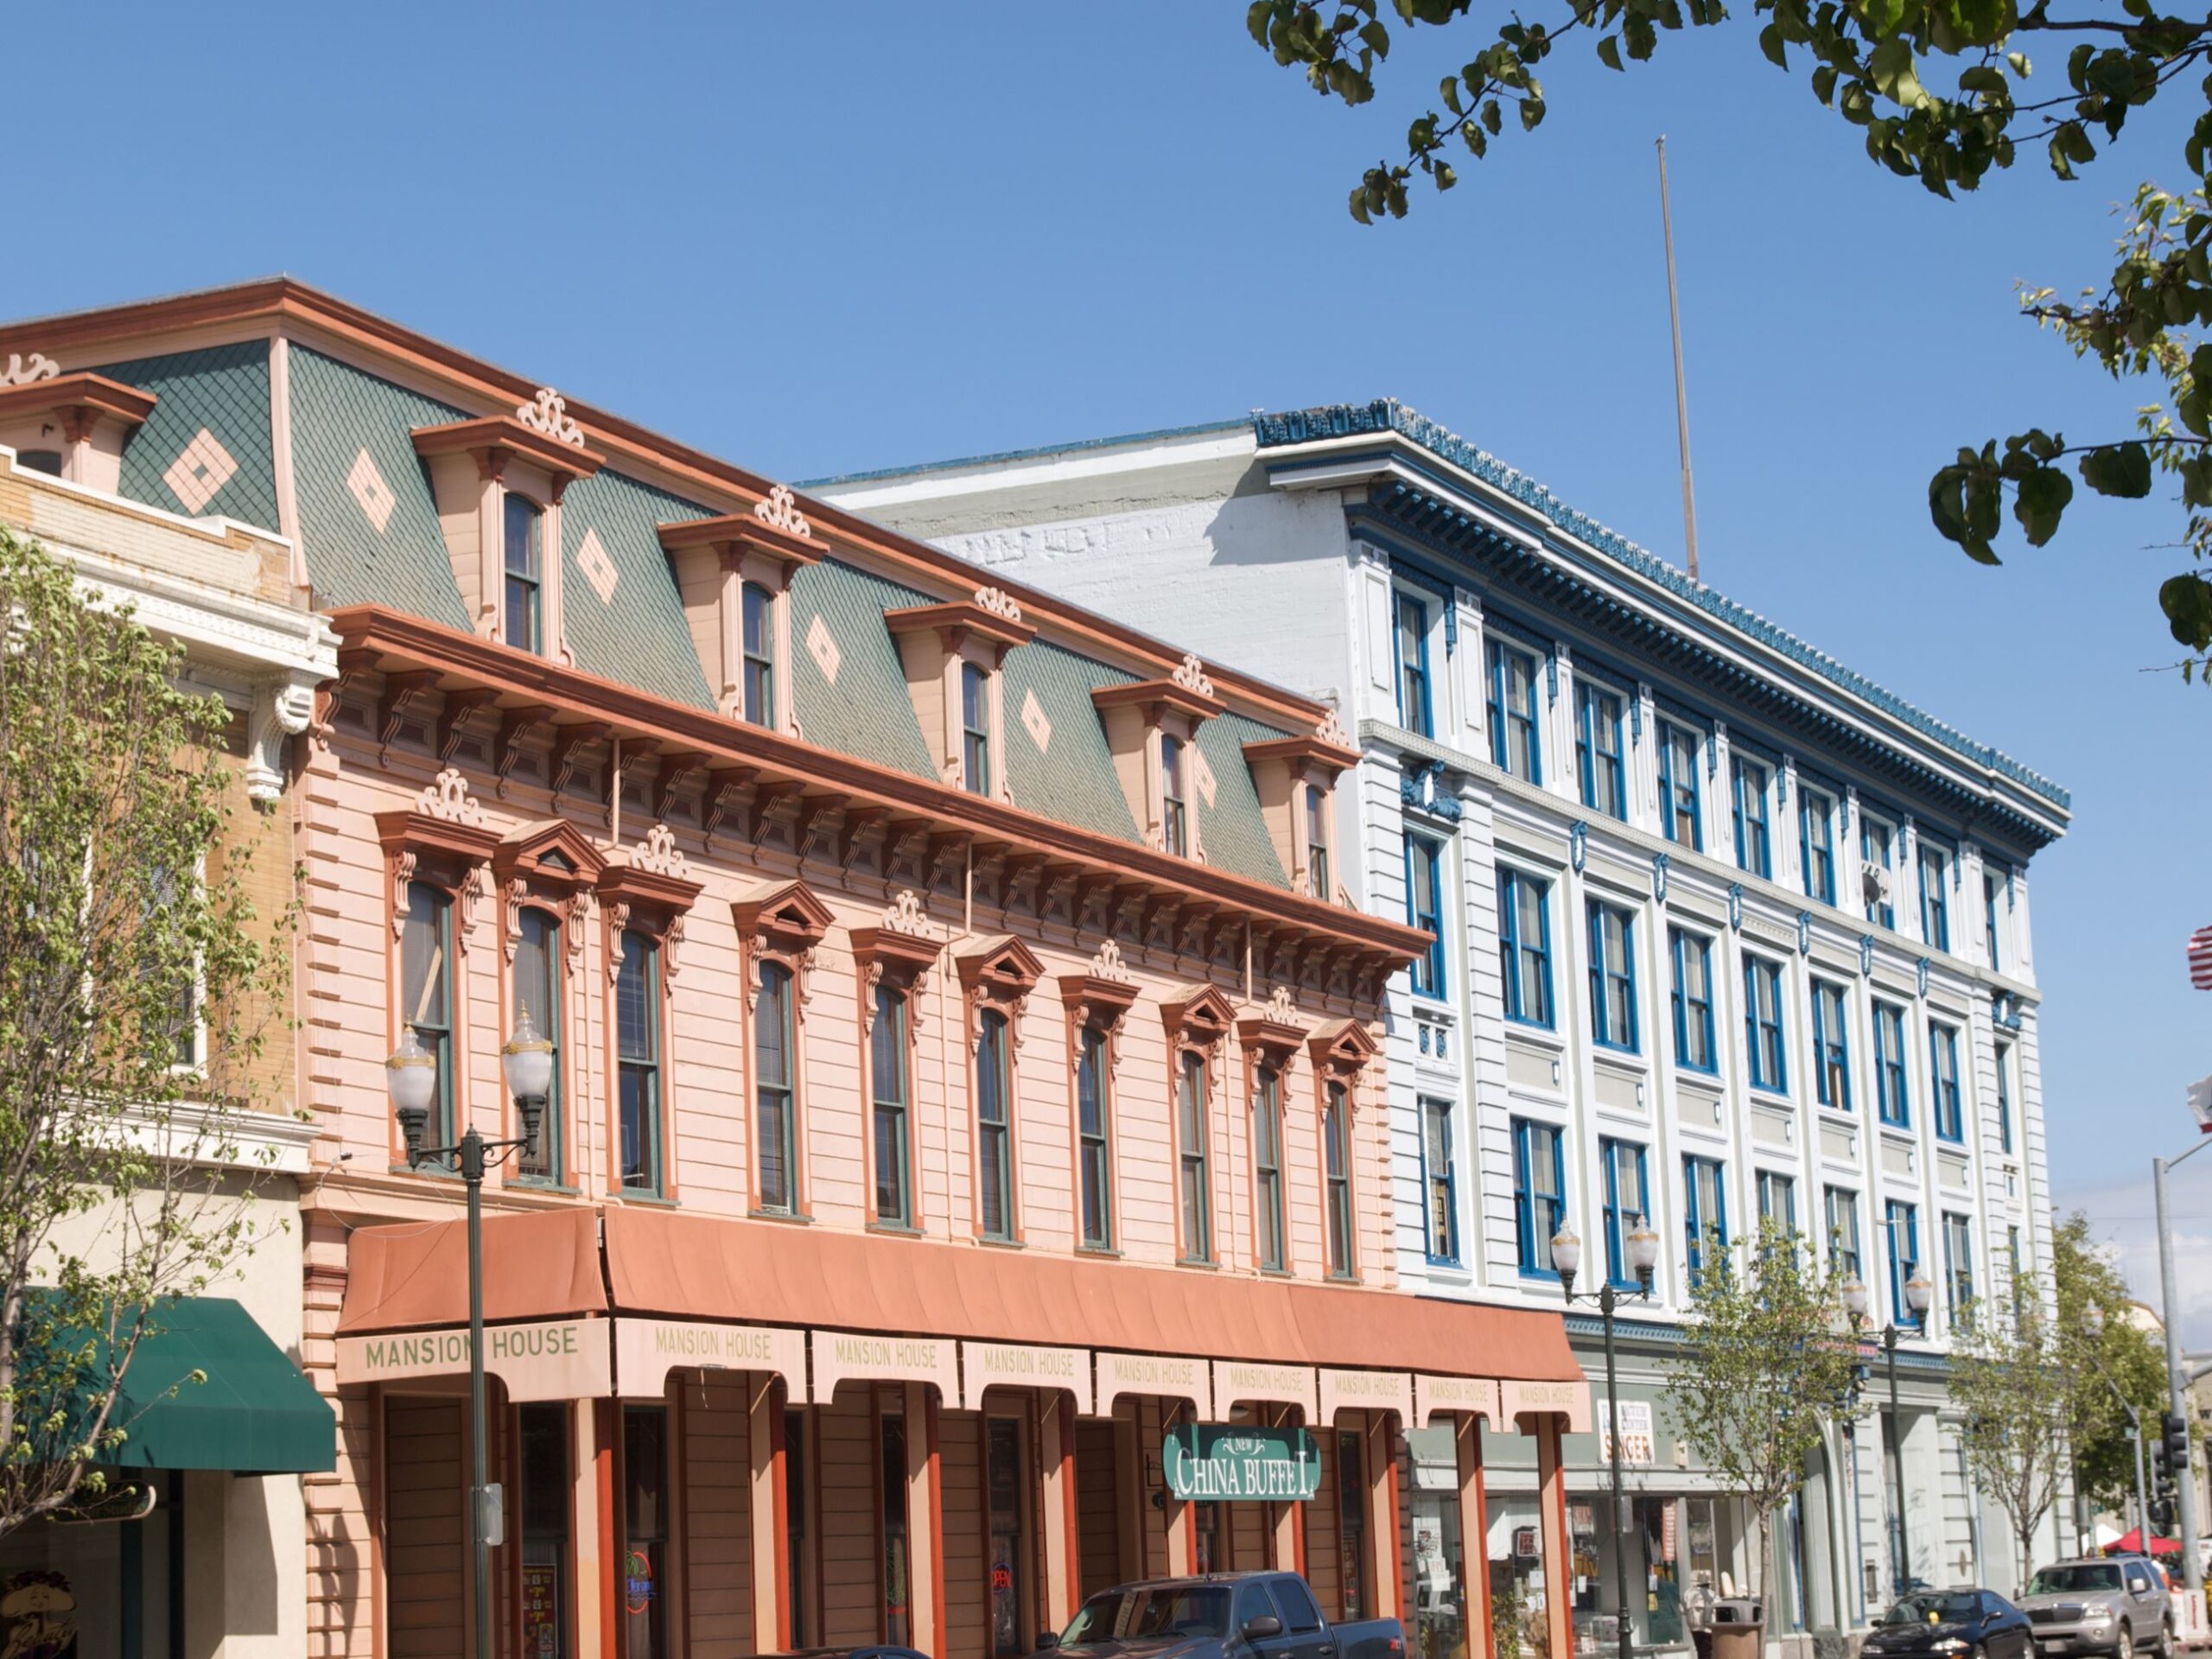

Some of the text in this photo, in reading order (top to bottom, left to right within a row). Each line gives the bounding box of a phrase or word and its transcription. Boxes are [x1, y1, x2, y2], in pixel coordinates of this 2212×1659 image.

[493, 1327, 578, 1359] HOUSE
[655, 1326, 772, 1360] MANSION HOUSE
[836, 1339, 938, 1369] MANSION HOUSE
[984, 1349, 1074, 1376] MANSION HOUSE
[1114, 1359, 1194, 1386] MANSION HOUSE
[1230, 1367, 1303, 1392] MANSION HOUSE
[1335, 1375, 1400, 1397] MANSION HOUSE
[1428, 1382, 1488, 1402] MANSION HOUSE
[1519, 1384, 1574, 1404] MANSION HOUSE
[1235, 1437, 1253, 1452] NEW
[1605, 1434, 1649, 1460] SNGER
[1177, 1447, 1309, 1496] CHINA BUFFET
